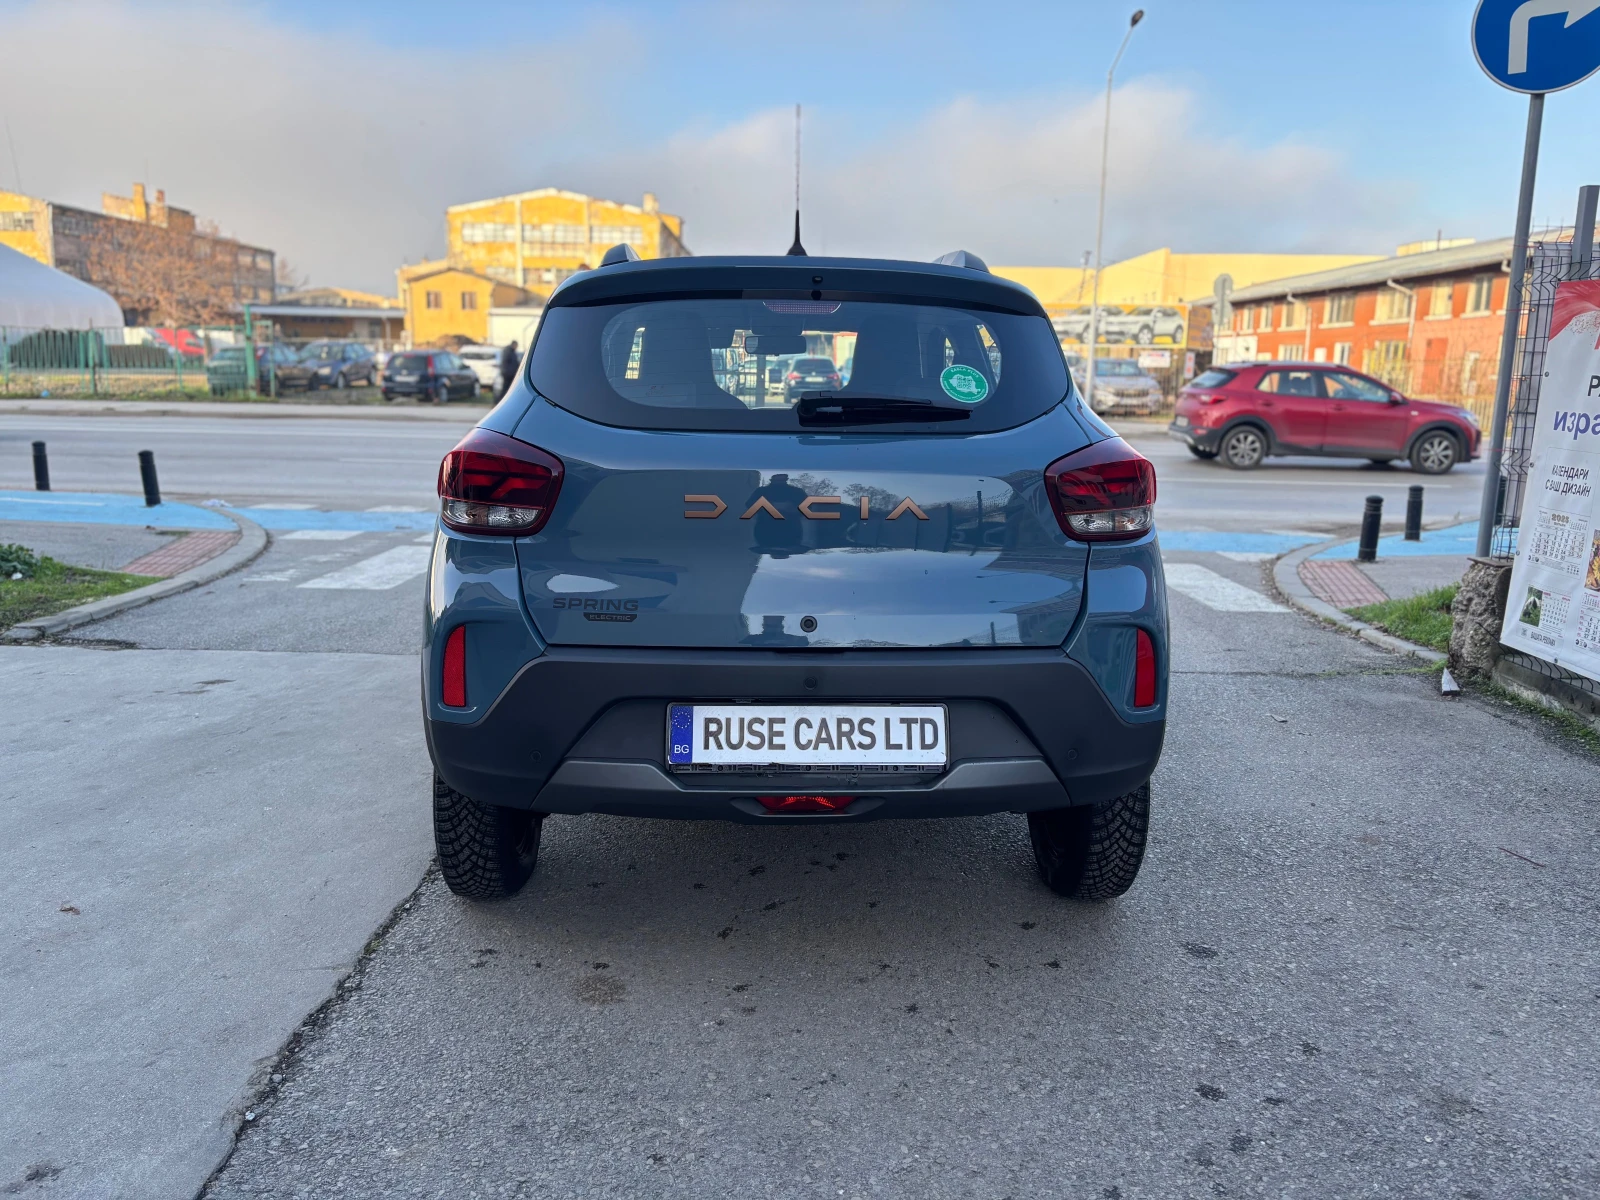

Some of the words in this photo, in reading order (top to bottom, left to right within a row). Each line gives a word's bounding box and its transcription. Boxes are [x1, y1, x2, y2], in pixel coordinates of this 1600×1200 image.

[1560, 482, 1592, 498] ДИЗАЙН
[684, 494, 930, 521] DACIA
[552, 597, 639, 612] SPRING
[703, 717, 786, 751] RUSE
[794, 717, 877, 751] CARS
[884, 717, 939, 751] LTD
[674, 744, 690, 754] BG
